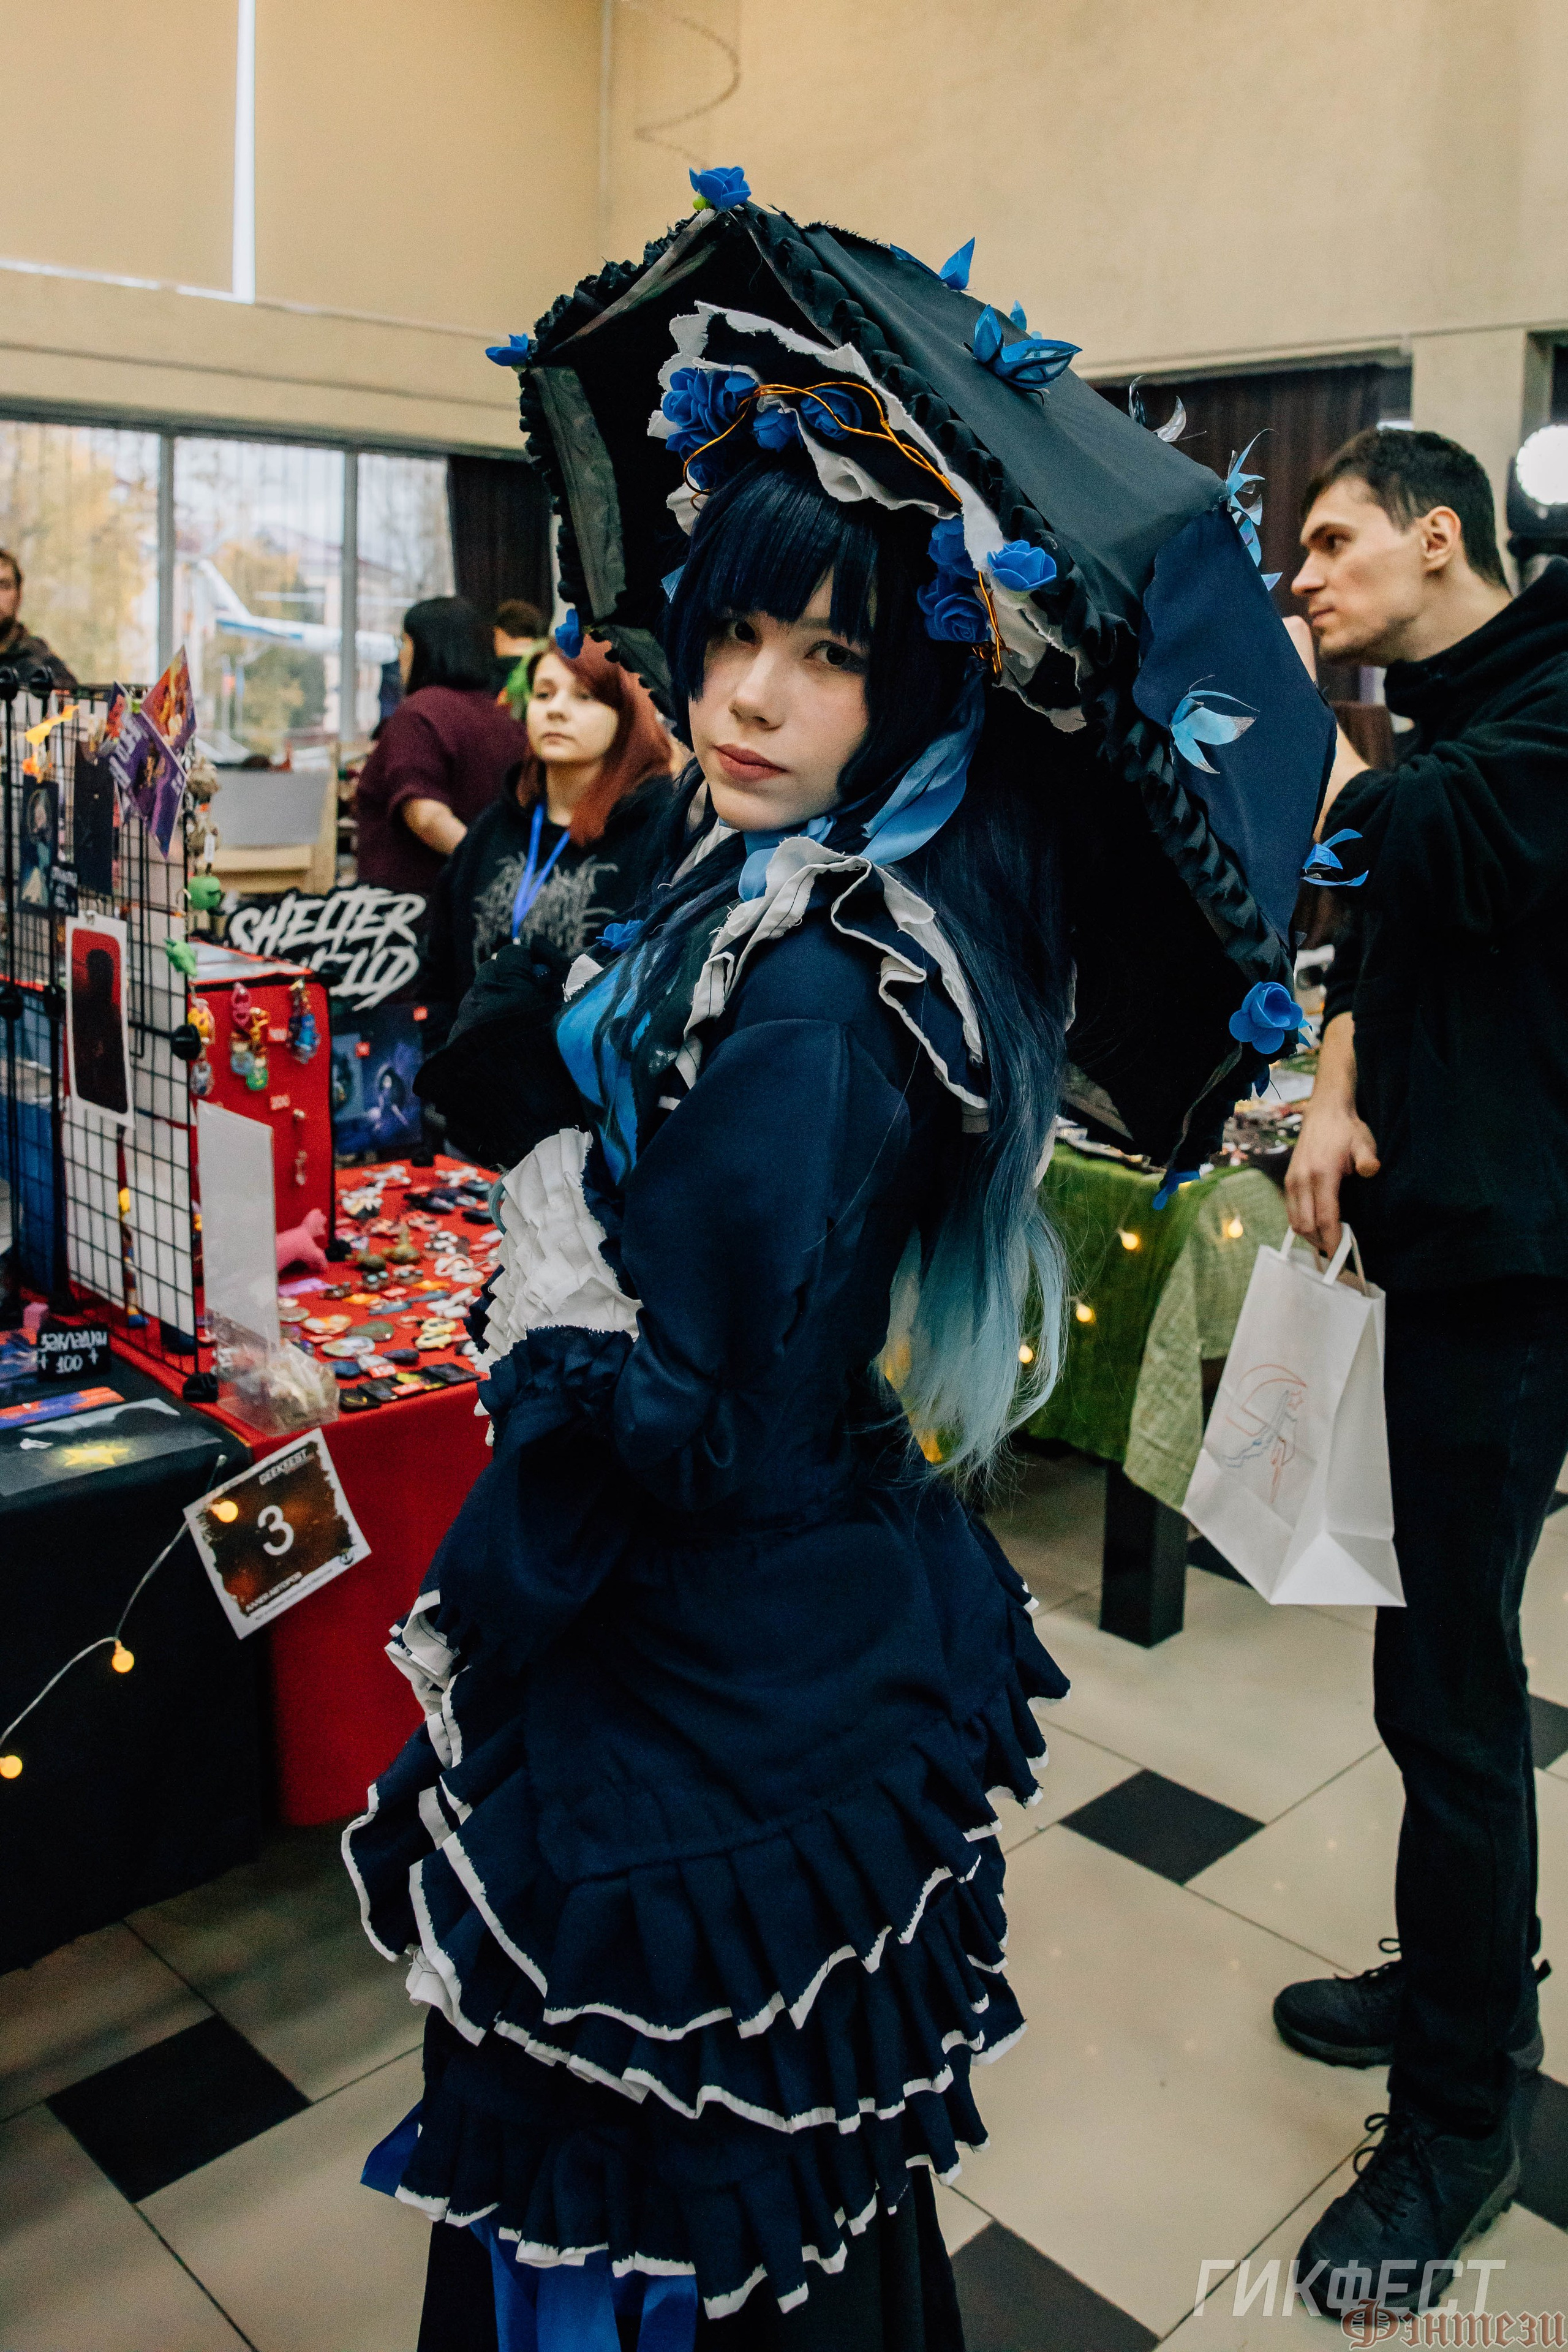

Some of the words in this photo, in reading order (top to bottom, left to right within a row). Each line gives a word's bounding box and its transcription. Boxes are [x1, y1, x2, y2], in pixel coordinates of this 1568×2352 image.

[229, 885, 426, 957] SHELTER
[56, 1354, 83, 1374] 100
[257, 1504, 295, 1556] 3
